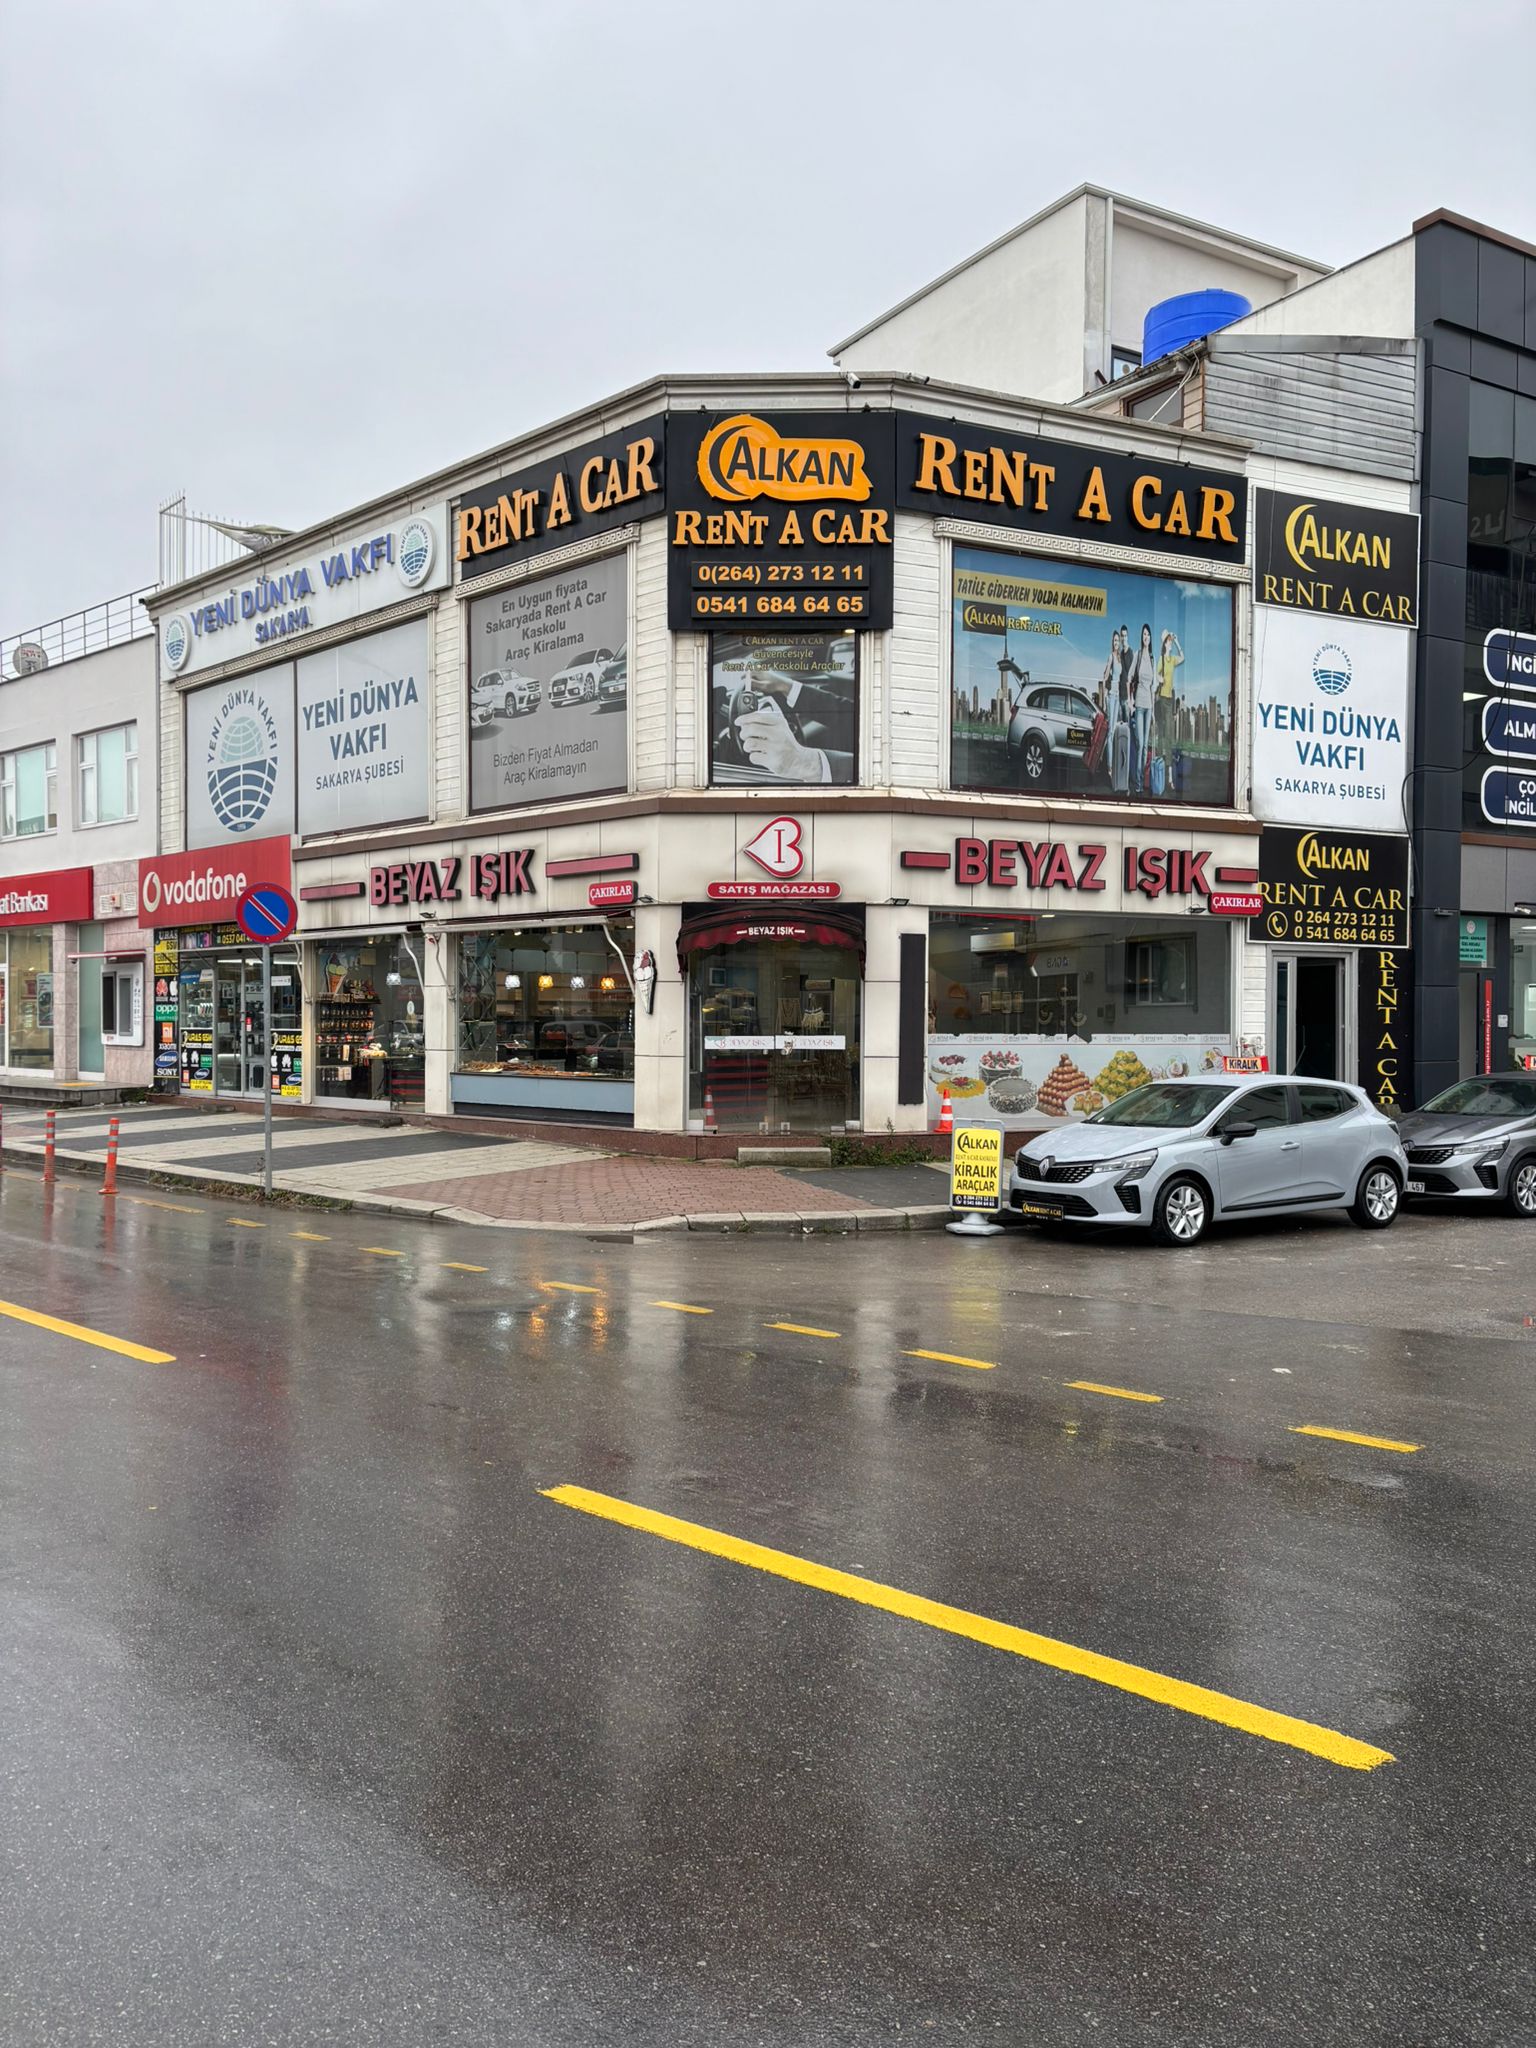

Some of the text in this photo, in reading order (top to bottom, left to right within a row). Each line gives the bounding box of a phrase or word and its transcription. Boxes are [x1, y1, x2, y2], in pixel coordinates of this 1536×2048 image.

[725, 435, 855, 487] ALKAN
[456, 436, 659, 562] RENT A CAR
[915, 431, 1239, 543] RENT A CAR
[671, 508, 893, 545] RENT A CAR
[1299, 513, 1392, 570] ALKAN
[189, 588, 239, 637] YENİ
[240, 567, 316, 620] DÜNYA
[320, 532, 397, 588] VAKFI
[698, 564, 864, 585] 0(264) 273 12 11
[501, 578, 588, 614] En Uygun fiyata
[696, 596, 864, 613] 0541 684 64 65
[957, 576, 1104, 612] TATİLE GİDERKEN YOLDA KALMAYIN
[1263, 573, 1415, 623] RENT A CAR
[255, 605, 314, 644] SAKARYA
[485, 591, 608, 634] Sakaryada Rent A Car
[521, 618, 567, 641] Kaskolu
[504, 632, 585, 662] Araç Kiralama
[302, 676, 419, 731] YENİ DÜNYA
[207, 689, 278, 764] YENİ DÜNYA VAKFI
[1258, 702, 1402, 743] YENİ DÜNYA
[329, 722, 388, 761] VAKFI
[493, 737, 600, 768] Bizden Fiyat Almadan
[1295, 740, 1365, 771] VAKFI
[315, 755, 405, 791] SAKARYA ŞUBESİ
[503, 761, 588, 786] Araç Kiralamayın
[1274, 777, 1387, 801] SAKARYA ŞUBESİ
[955, 837, 1214, 899] BEYAZ IŞIK
[1305, 838, 1370, 872] ALKAN
[163, 866, 248, 906] vodafone
[371, 848, 537, 907] BEYAZ IŞIK
[589, 884, 633, 902] ÇAKIRLAR
[718, 884, 831, 896] SATIŞ MAĞAZASI
[1212, 895, 1262, 910] ÇAKIRLAR
[1257, 881, 1406, 912] RENT A CAR
[748, 926, 795, 936] BEYAZ IŞIK
[1294, 909, 1396, 927] 0 264 273 12 11
[1294, 926, 1396, 942] 0 541 684 64 65
[1375, 950, 1400, 1025] RENT
[1375, 1031, 1399, 1050] A
[157, 1067, 178, 1076] SONY
[961, 1134, 999, 1151] ALKAN
[954, 1161, 998, 1179] KİRALIK
[955, 1179, 995, 1194] ARAÇLAR
